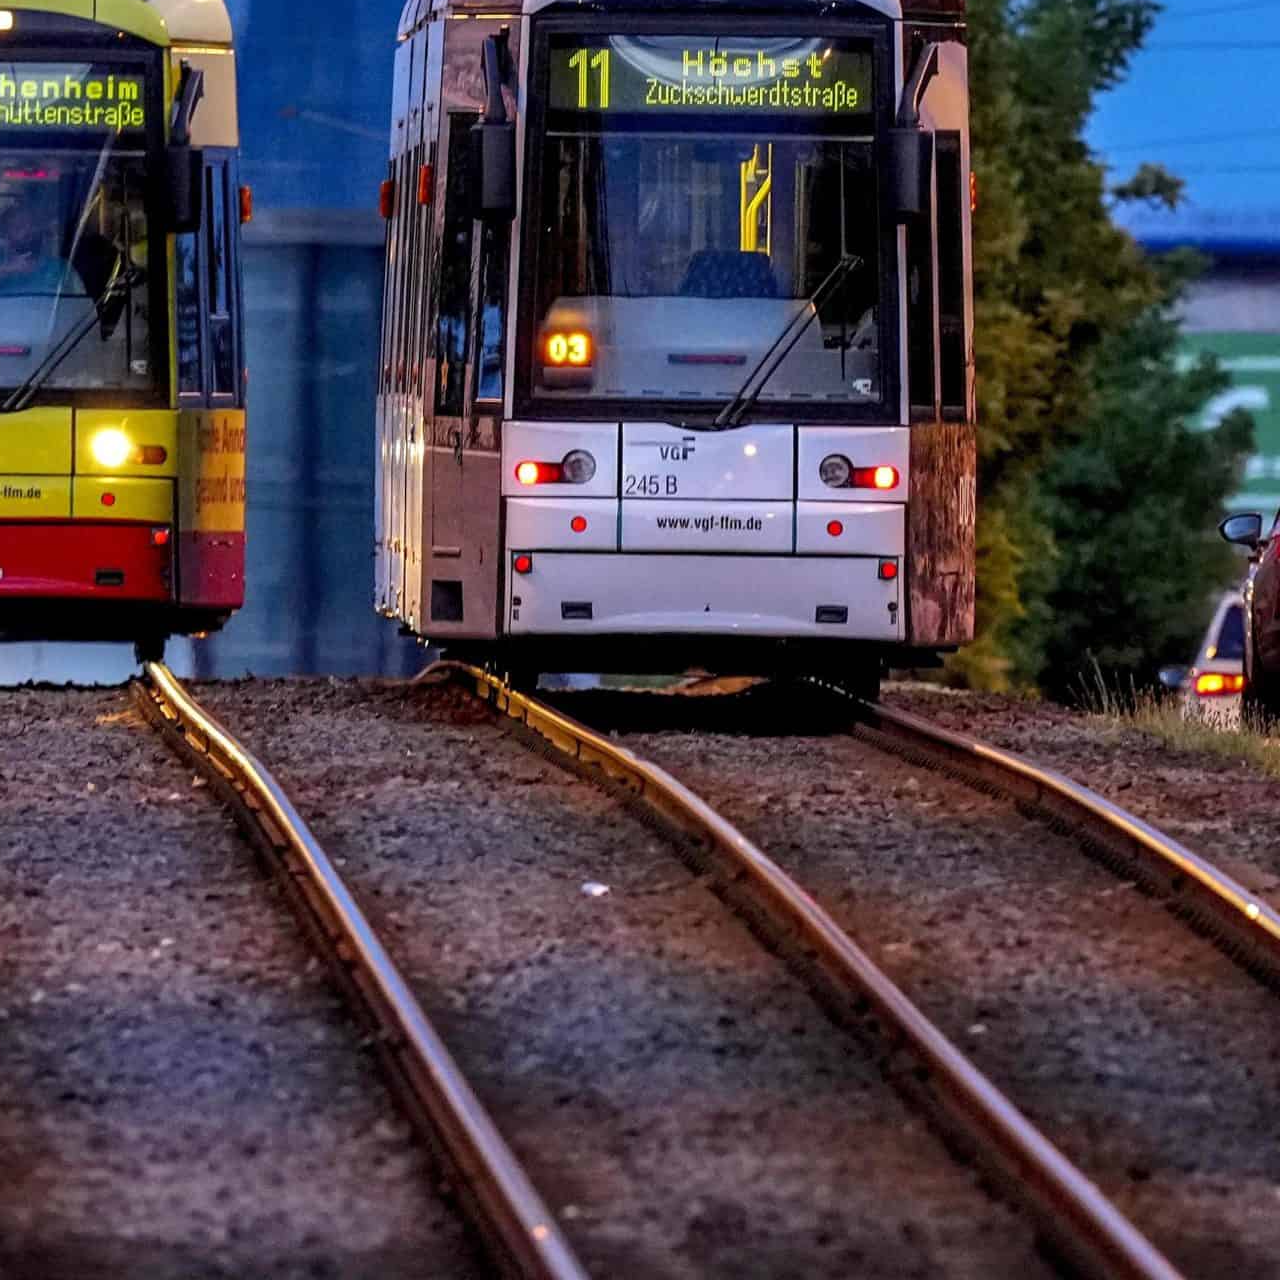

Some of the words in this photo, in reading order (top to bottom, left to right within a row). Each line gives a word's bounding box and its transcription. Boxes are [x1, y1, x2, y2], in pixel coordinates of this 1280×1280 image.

[568, 47, 610, 109] 11
[681, 49, 823, 79] Höchst
[645, 77, 859, 111] Zuckschwerdtstraße
[548, 332, 589, 364] 03
[659, 436, 696, 461] VGF
[625, 475, 660, 496] 245
[665, 476, 678, 496] B
